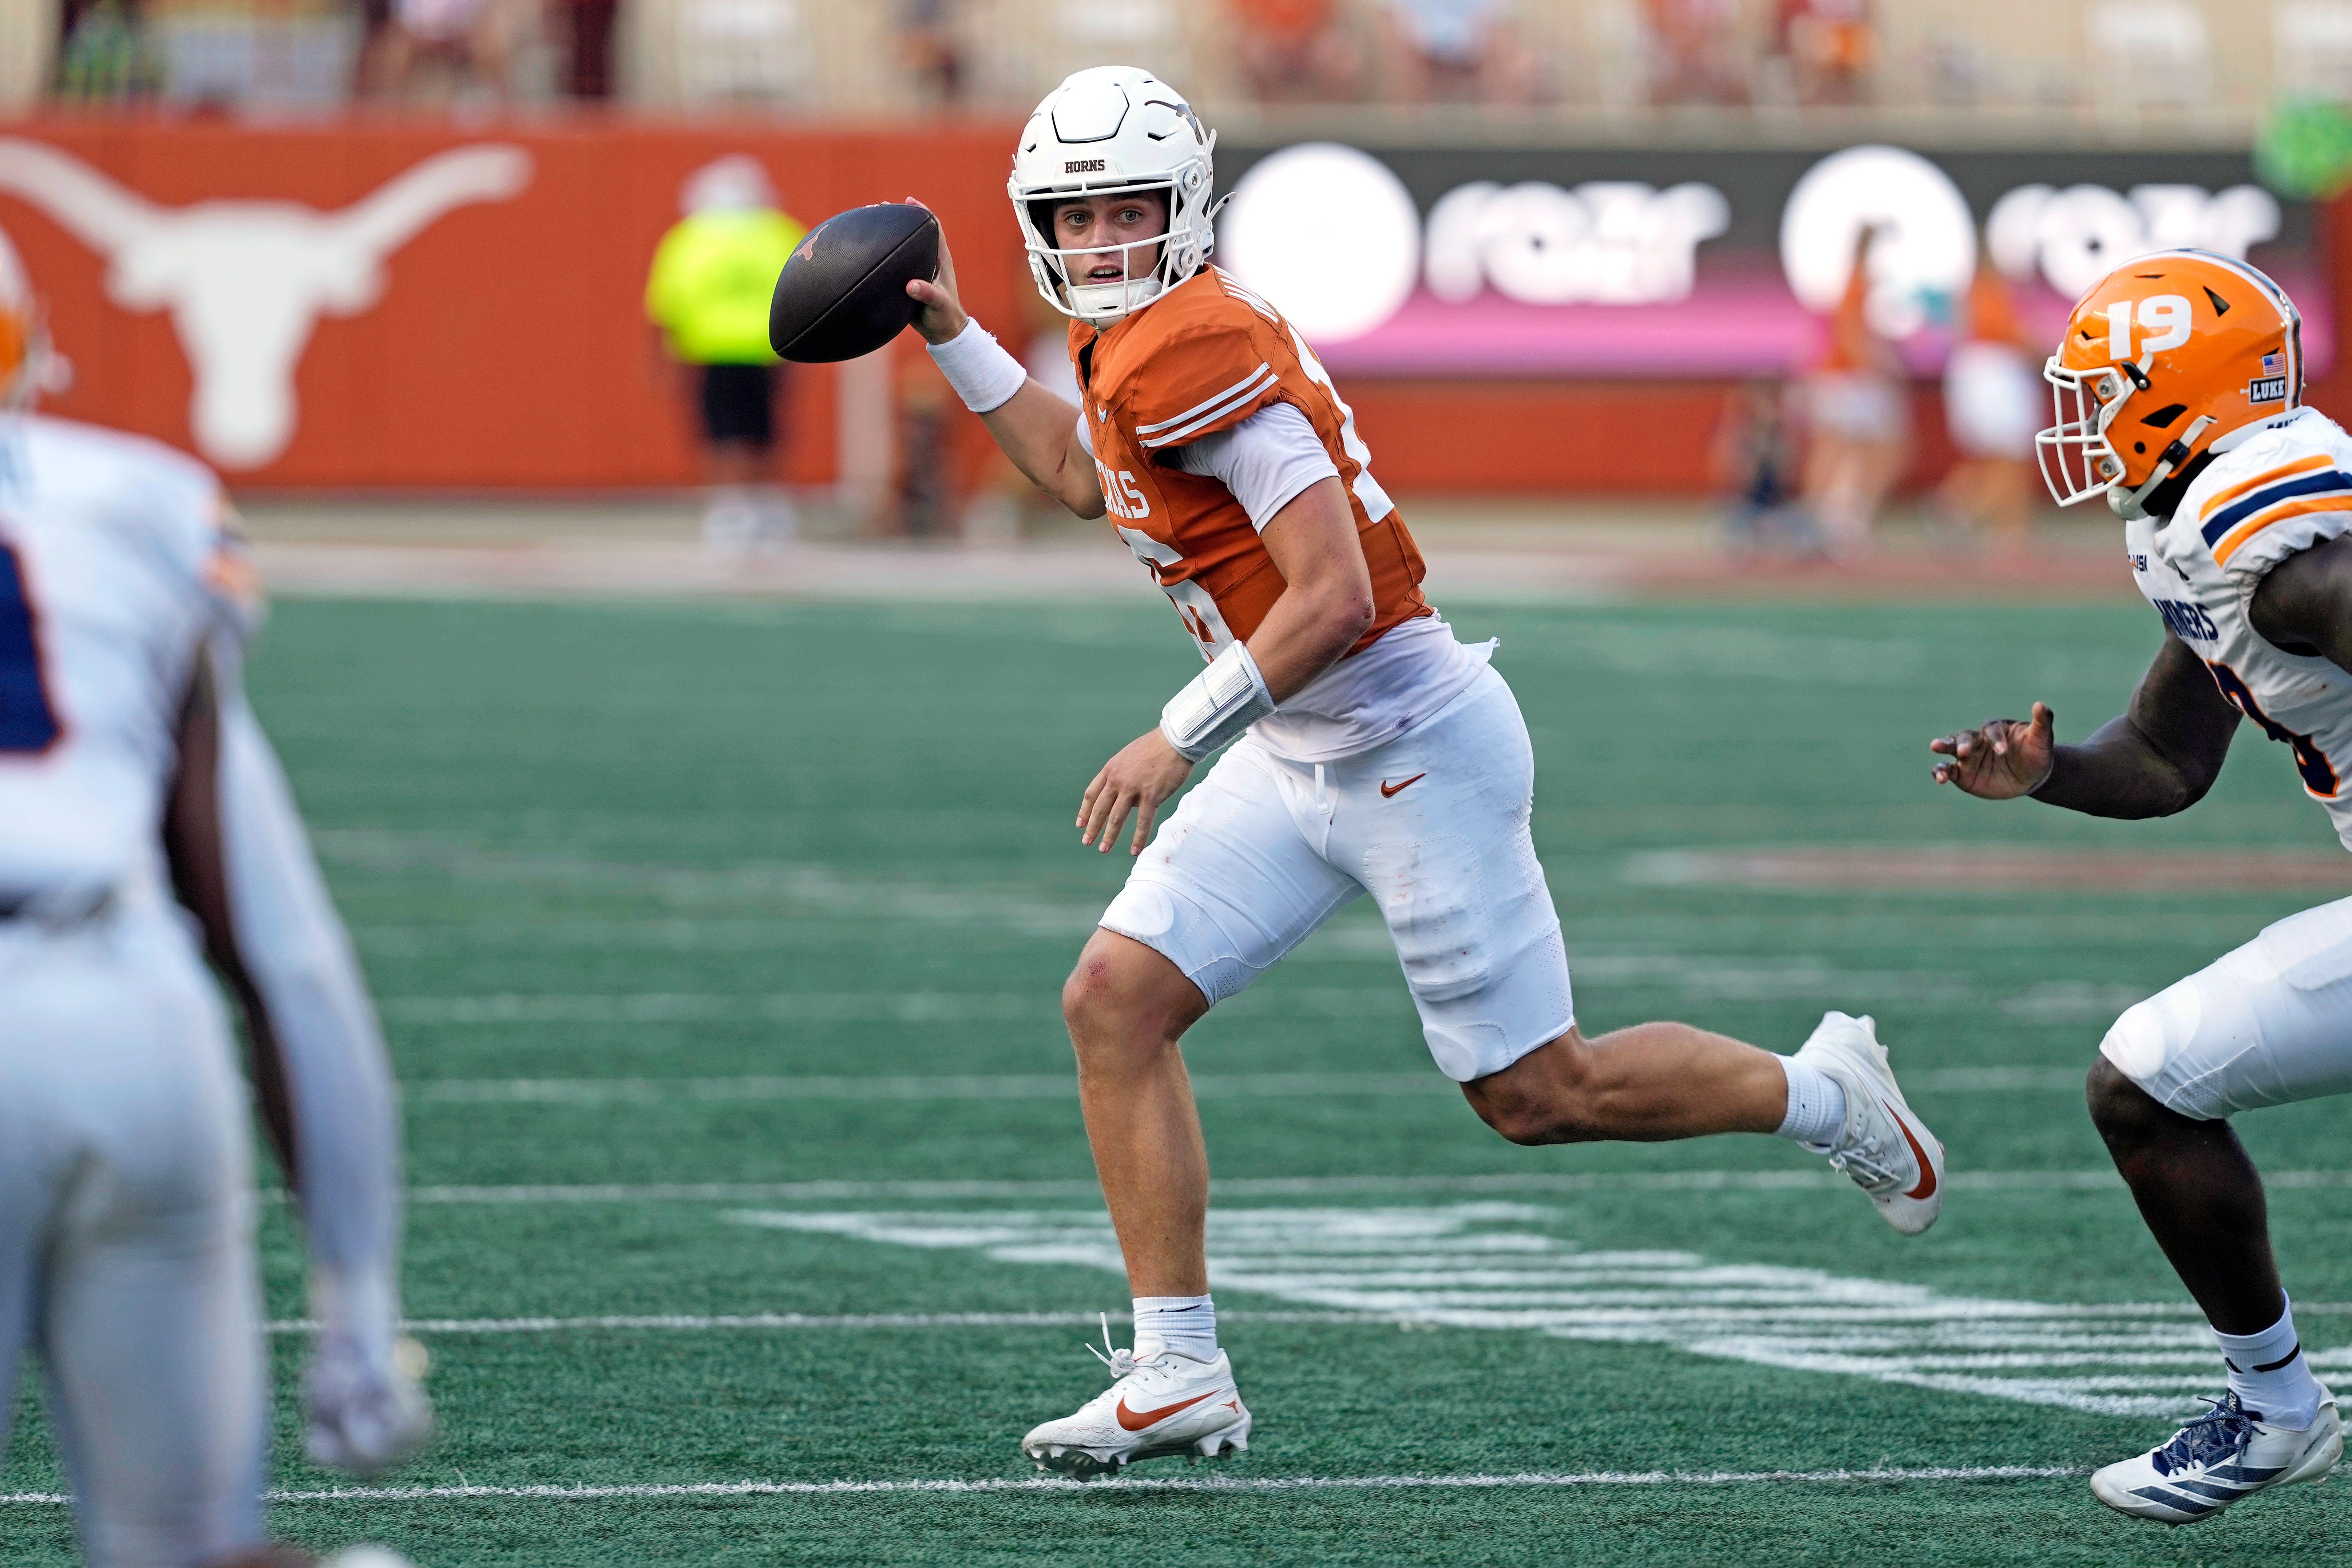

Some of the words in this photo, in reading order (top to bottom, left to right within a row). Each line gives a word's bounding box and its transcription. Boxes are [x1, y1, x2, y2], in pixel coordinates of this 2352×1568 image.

[1065, 159, 1105, 173] HORNS
[2107, 294, 2192, 360] 19
[2252, 380, 2285, 400] LUKE
[1094, 456, 1150, 519] EXAS
